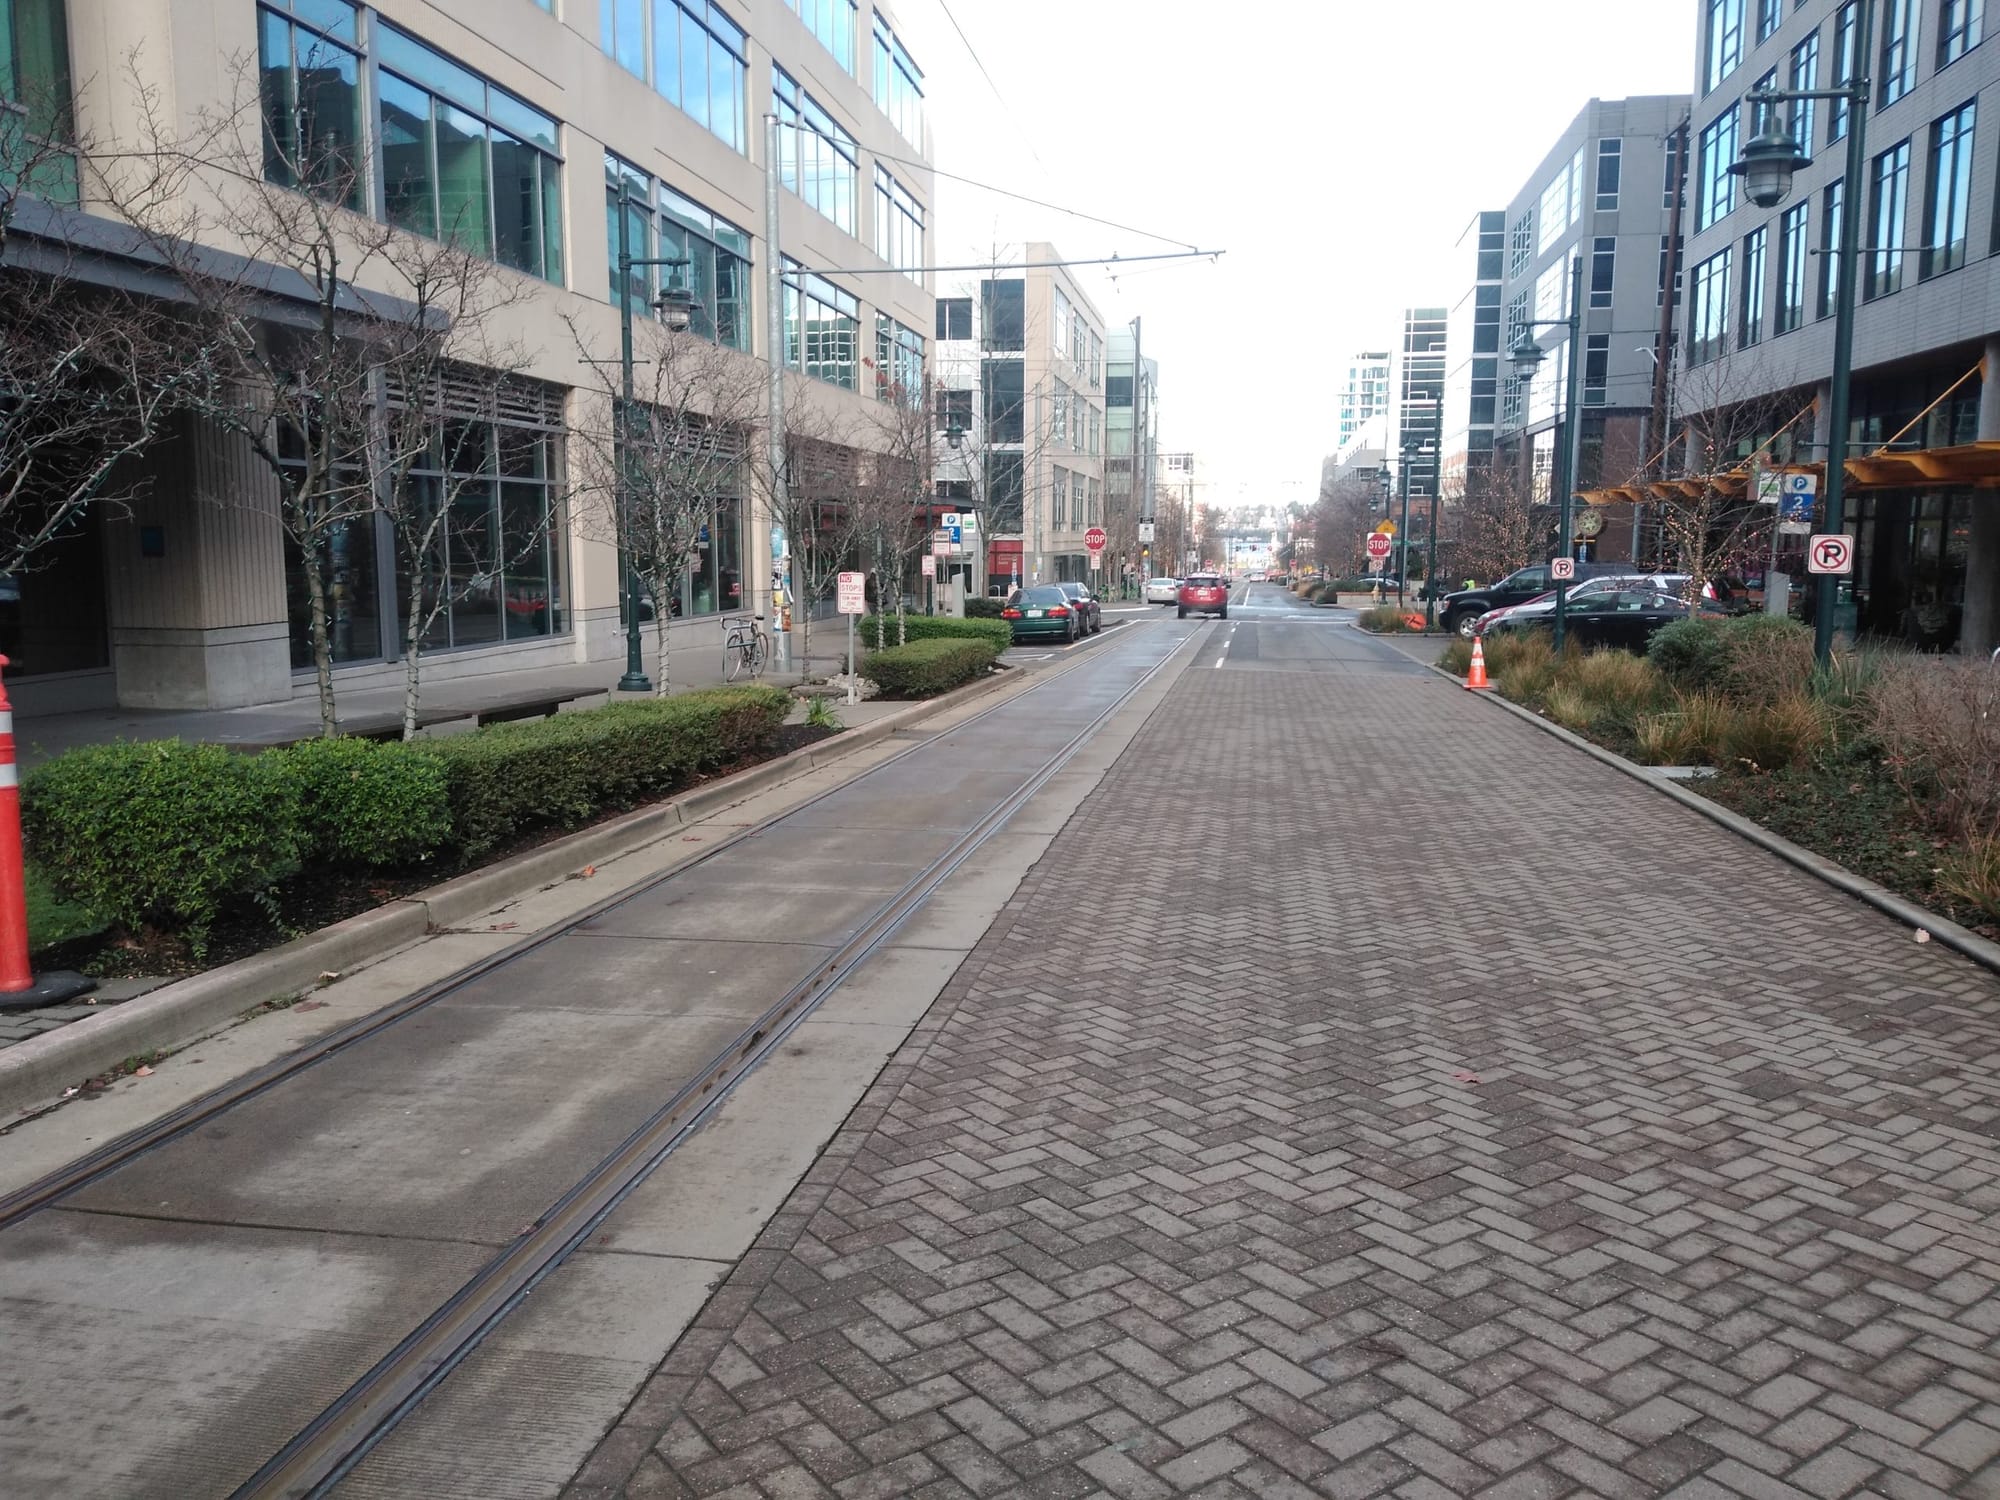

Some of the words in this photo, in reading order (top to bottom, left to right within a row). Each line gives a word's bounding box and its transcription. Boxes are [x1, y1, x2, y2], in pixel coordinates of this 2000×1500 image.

[1796, 479, 1805, 489] P
[1793, 496, 1804, 509] 2
[1085, 535, 1105, 544] STOP
[1369, 540, 1389, 549] STOP
[1823, 545, 1842, 564] P
